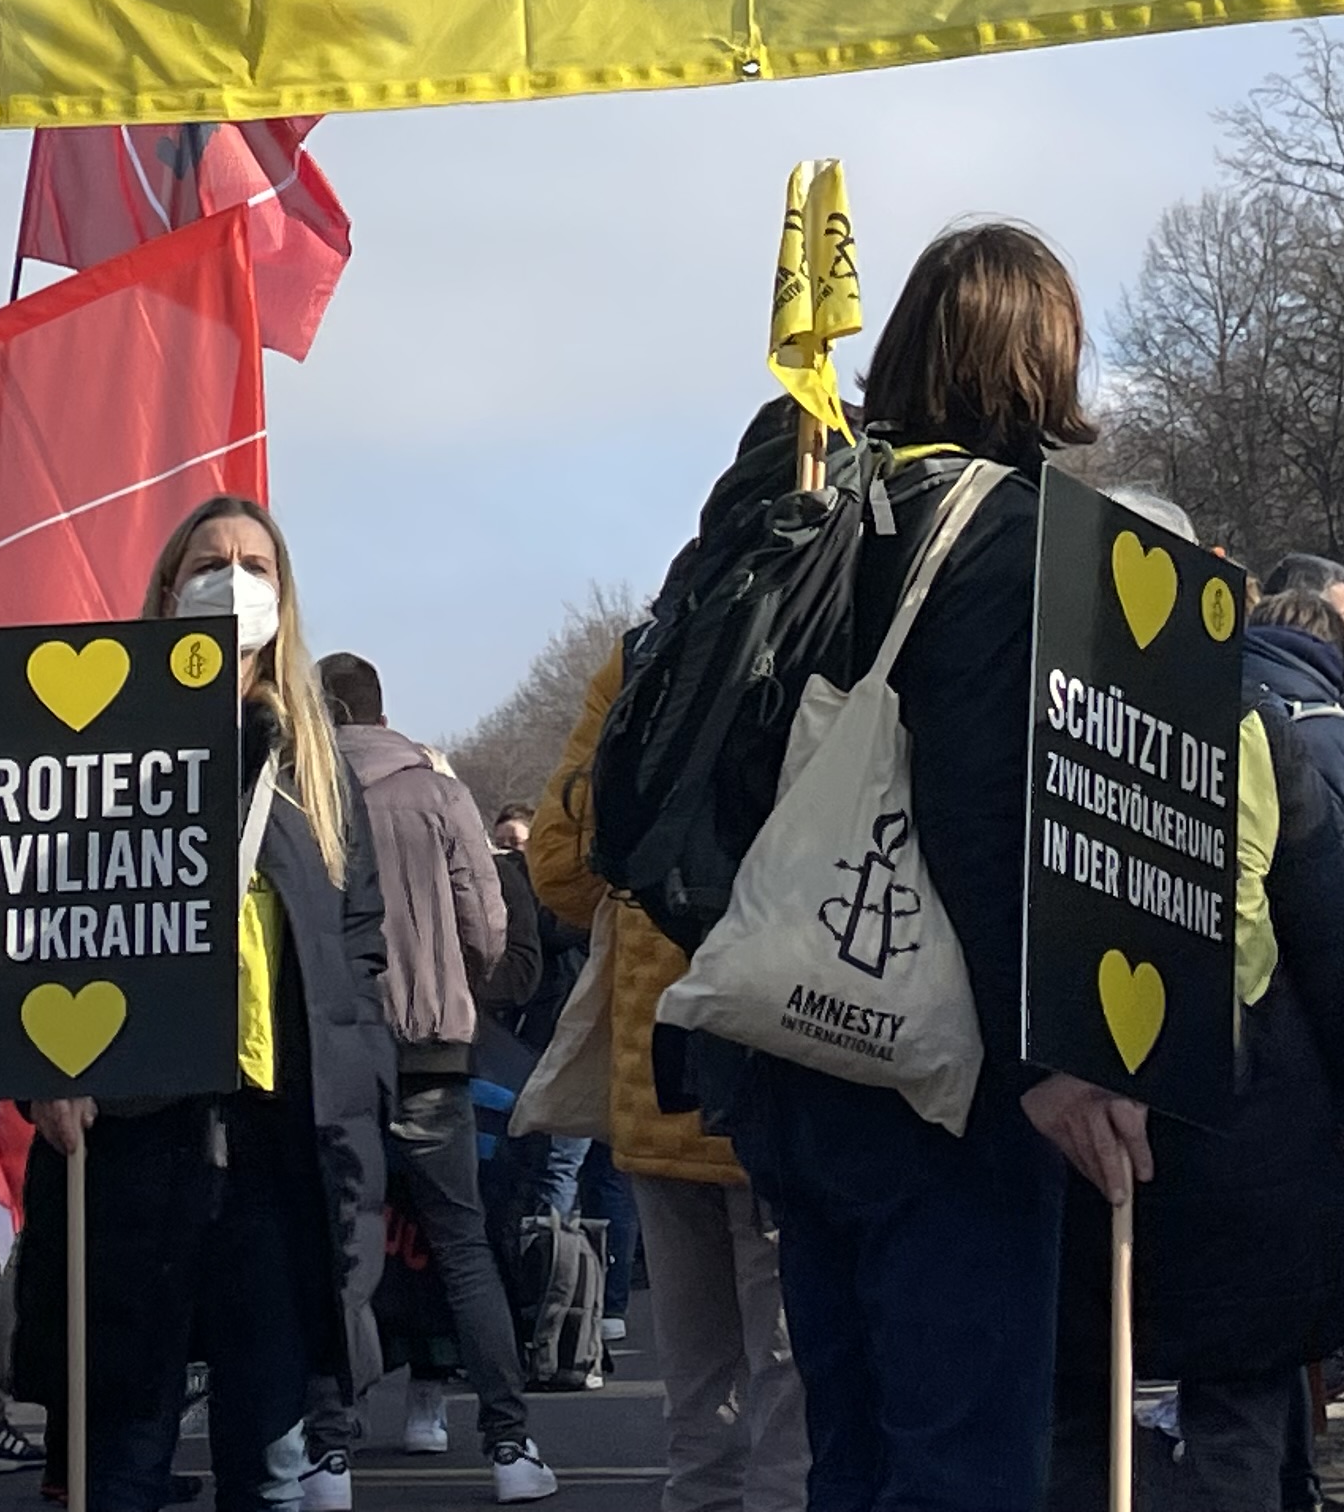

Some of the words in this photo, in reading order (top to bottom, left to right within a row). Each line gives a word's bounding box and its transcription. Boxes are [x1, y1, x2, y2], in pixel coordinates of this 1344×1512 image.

[1047, 668, 1173, 781] SCHÜTZT
[1180, 731, 1227, 808] DIE
[1045, 751, 1225, 871] ZIVILBEVÖLKERUNG
[1042, 818, 1067, 875] IN
[1074, 832, 1120, 898] DER
[1127, 855, 1223, 942] UKRAINE
[6, 900, 212, 963] UKRAINE
[780, 1012, 895, 1062] INTERNATIONAL
[786, 984, 907, 1043] AMNESTY
